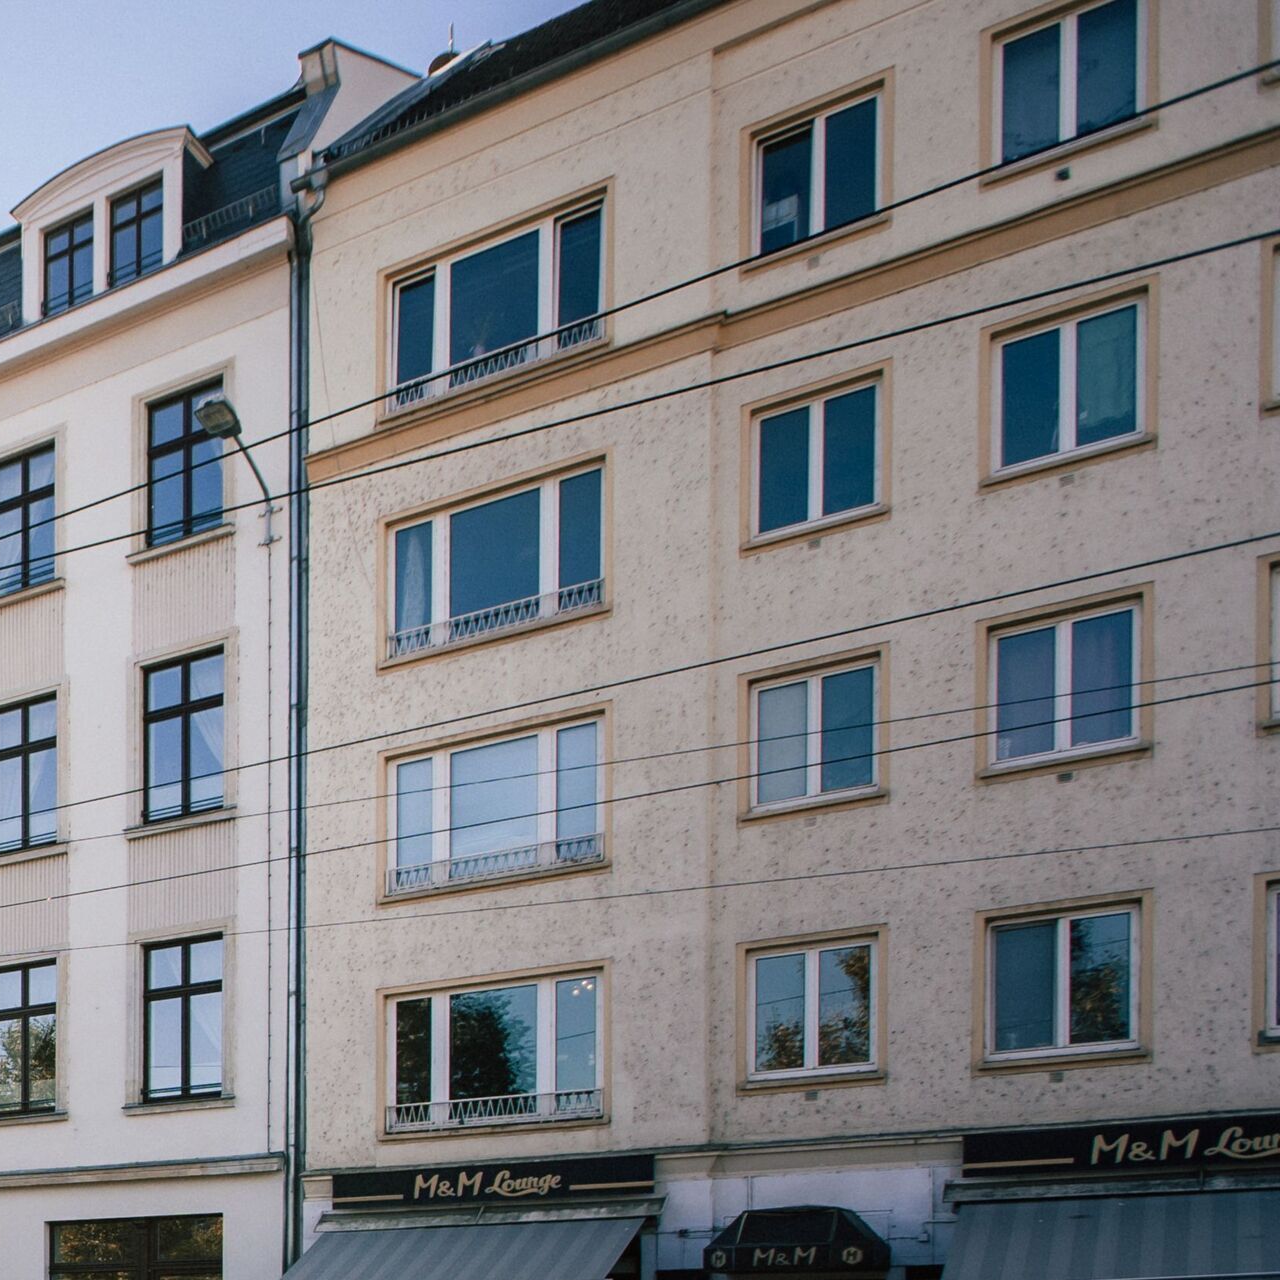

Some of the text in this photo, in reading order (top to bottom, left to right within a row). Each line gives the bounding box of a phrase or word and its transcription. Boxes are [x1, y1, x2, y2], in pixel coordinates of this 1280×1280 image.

[1091, 1128, 1200, 1165] M&M
[414, 1170, 562, 1199] M&M Lounge
[752, 1246, 817, 1267] M&M
